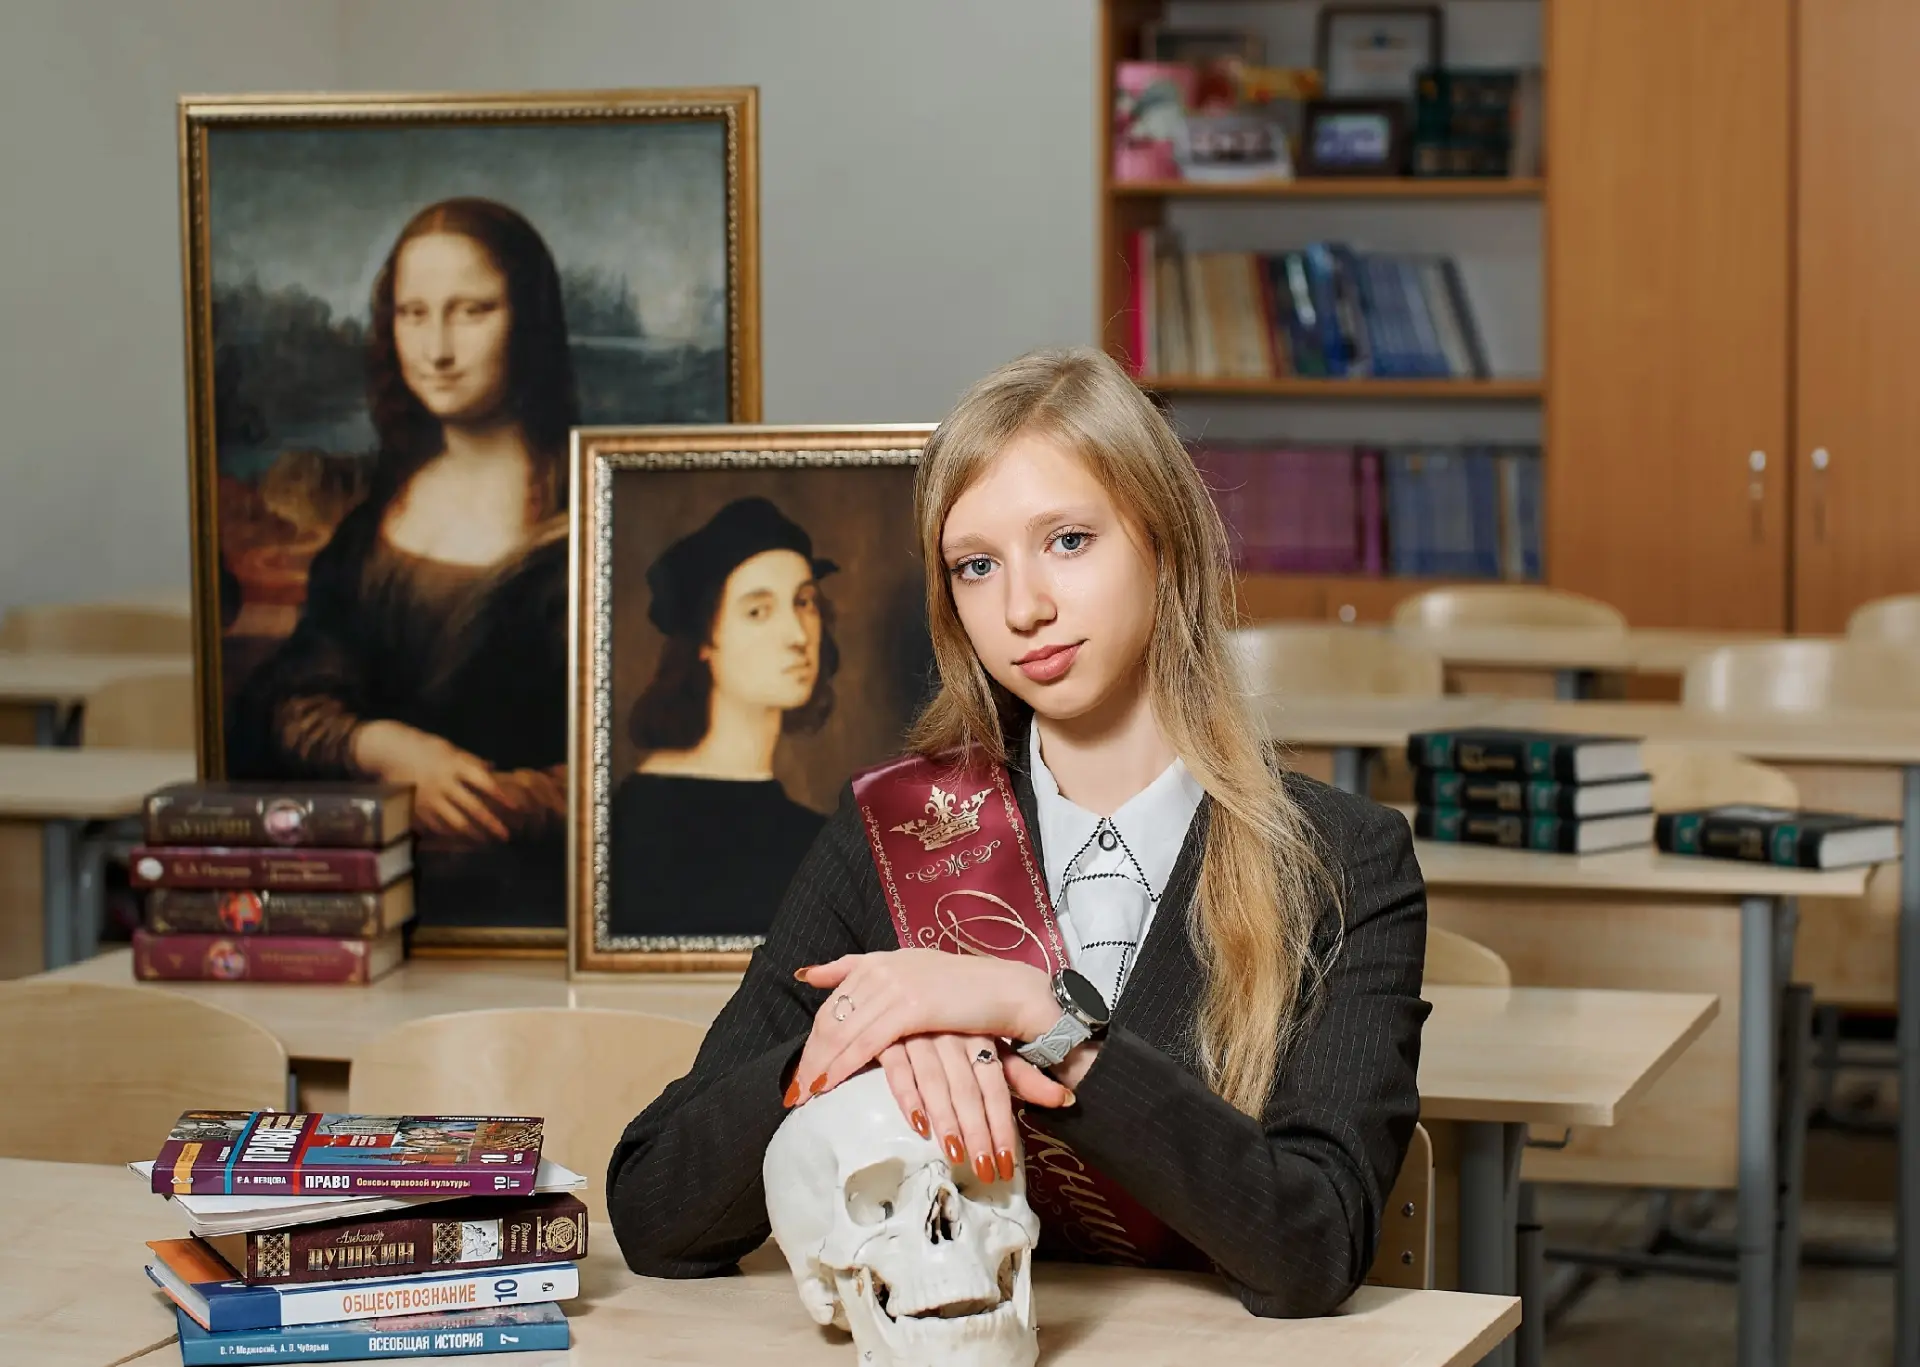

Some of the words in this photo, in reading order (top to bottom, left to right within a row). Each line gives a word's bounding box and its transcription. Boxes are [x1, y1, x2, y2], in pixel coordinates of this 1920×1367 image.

[241, 1128, 302, 1162] ПРАВО
[304, 1175, 350, 1189] ПРАВО
[356, 1177, 389, 1186] Основы
[390, 1178, 429, 1188] правовой
[431, 1179, 470, 1188] культуры
[336, 1230, 384, 1244] Александр
[307, 1242, 415, 1271] ПУШКИН
[343, 1284, 476, 1315] ОБЩЕСТВОЗНАНИЕ
[494, 1278, 518, 1302] 10
[297, 1343, 329, 1353] Чубарьян
[369, 1335, 430, 1352] ВСЕОБЩАЯ
[434, 1332, 484, 1350] ИСТОРИЯ
[500, 1334, 520, 1345] 7
